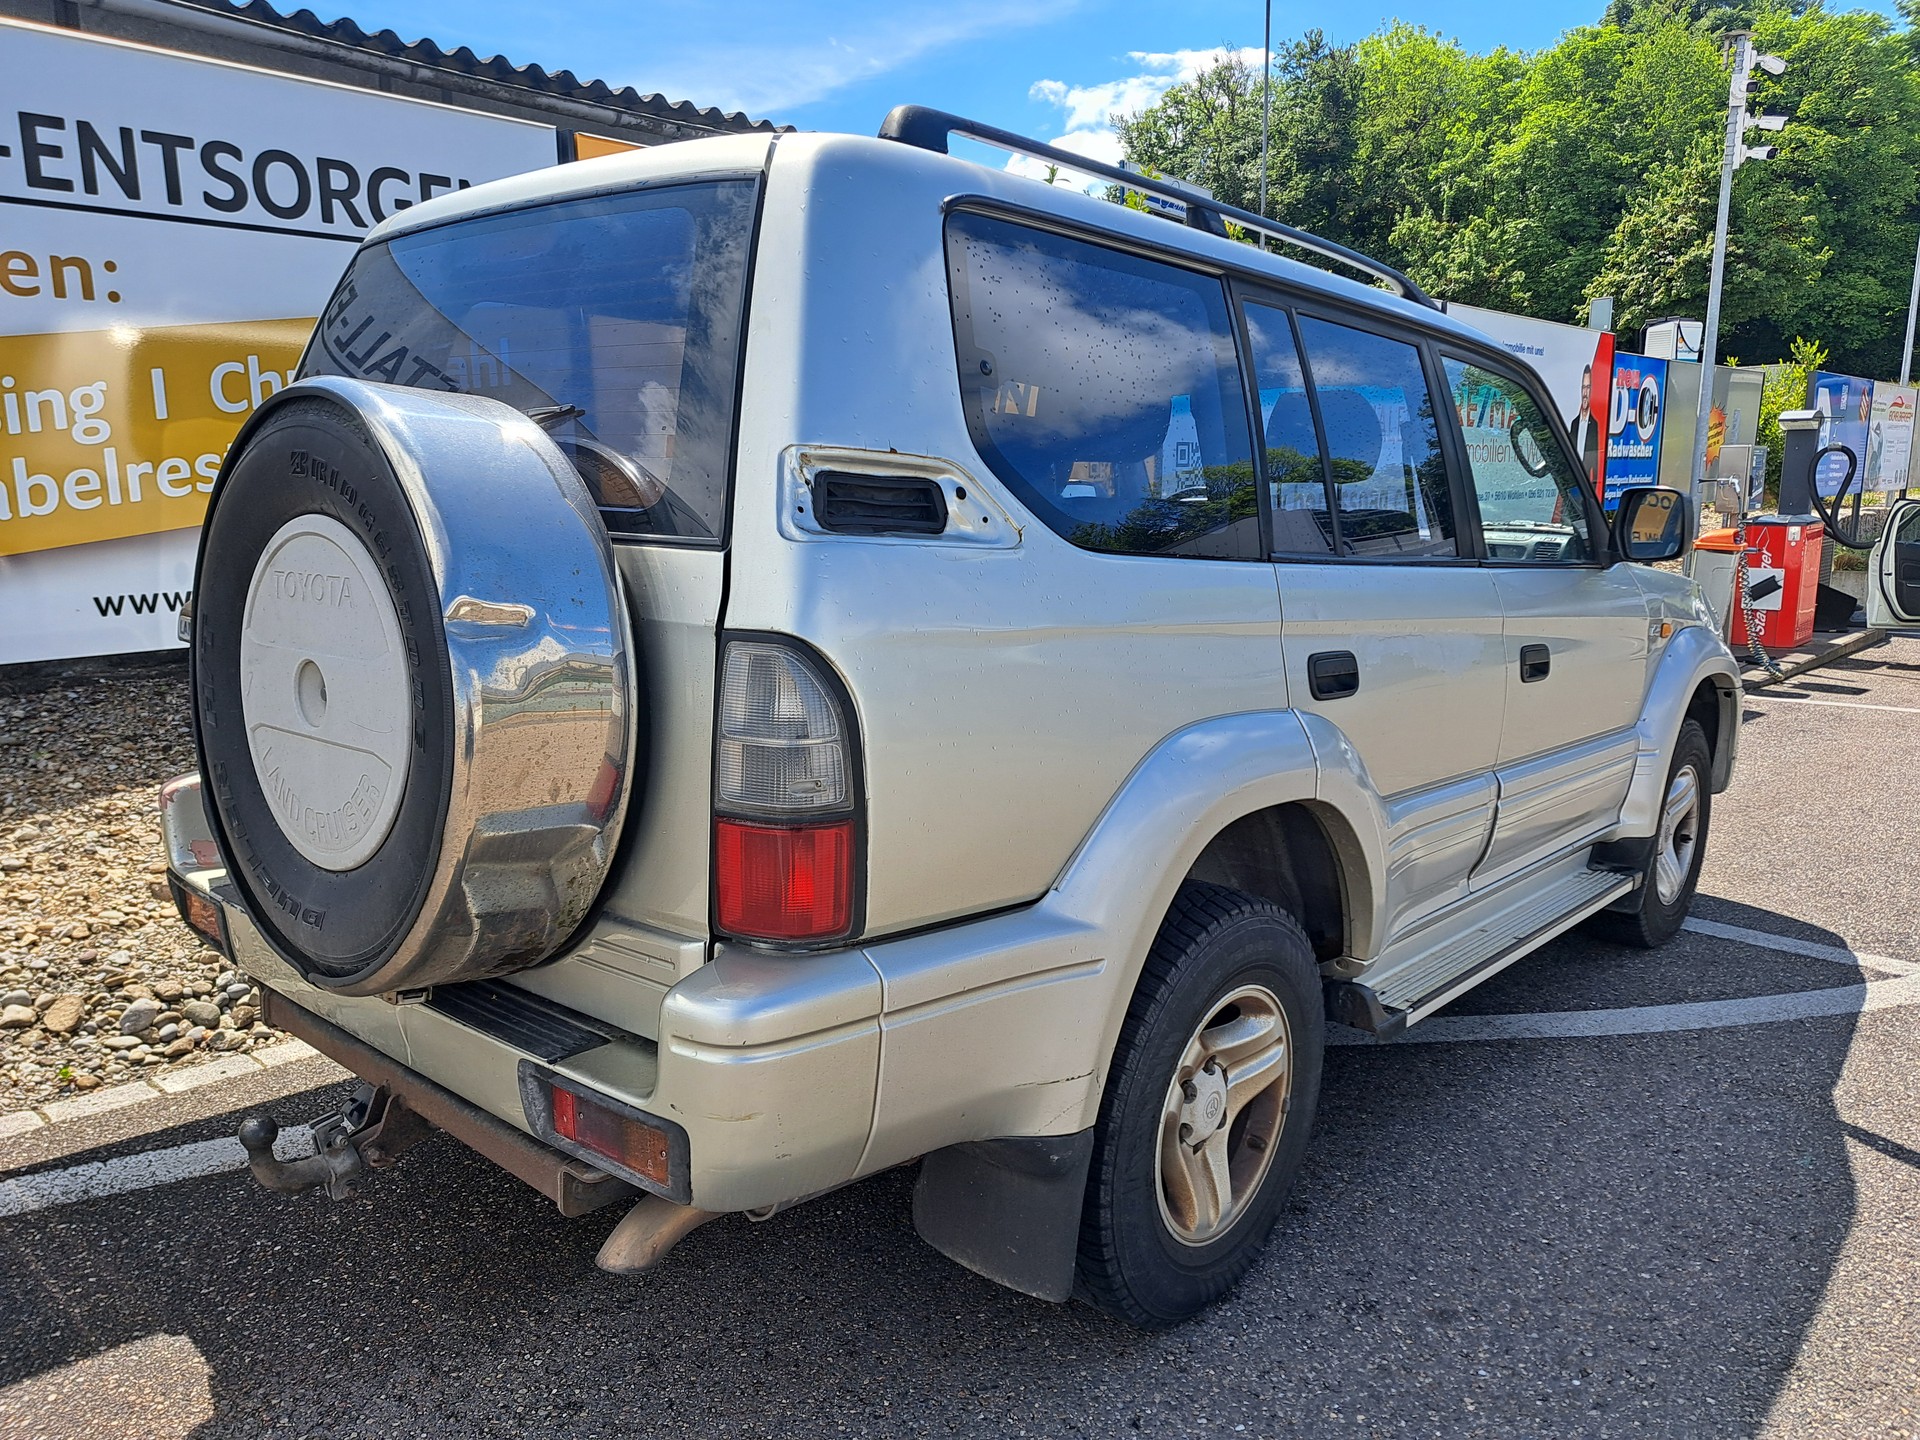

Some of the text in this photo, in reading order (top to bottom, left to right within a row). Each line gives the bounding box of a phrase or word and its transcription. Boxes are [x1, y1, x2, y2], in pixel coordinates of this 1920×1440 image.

[0, 111, 475, 229] -ENTSORG
[0, 374, 112, 445] ing
[0, 446, 230, 521] belres
[1607, 439, 1653, 459] Radwäscher
[1494, 490, 1507, 501] 5610
[92, 590, 192, 617] www
[273, 570, 353, 609] TOYOTA
[289, 449, 427, 754] BRIDGESTONE
[262, 745, 301, 823] LAND
[304, 773, 381, 845] CRUISER
